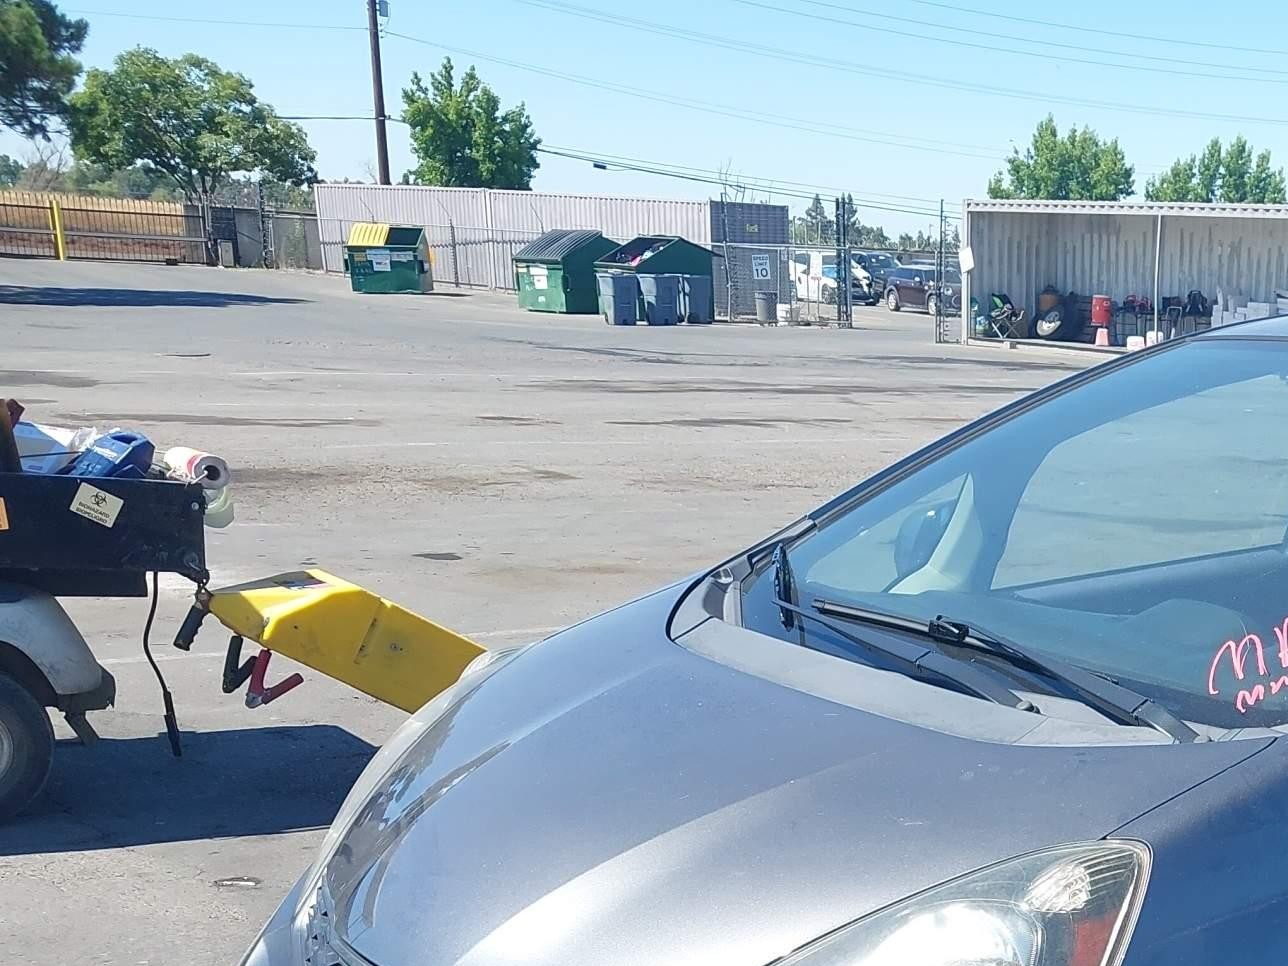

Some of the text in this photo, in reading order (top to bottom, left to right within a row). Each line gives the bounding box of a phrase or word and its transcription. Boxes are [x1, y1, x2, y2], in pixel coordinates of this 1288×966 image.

[755, 267, 769, 278] 10
[75, 507, 108, 524] BIOPELIGRO
[78, 501, 111, 518] BIOHAZARD
